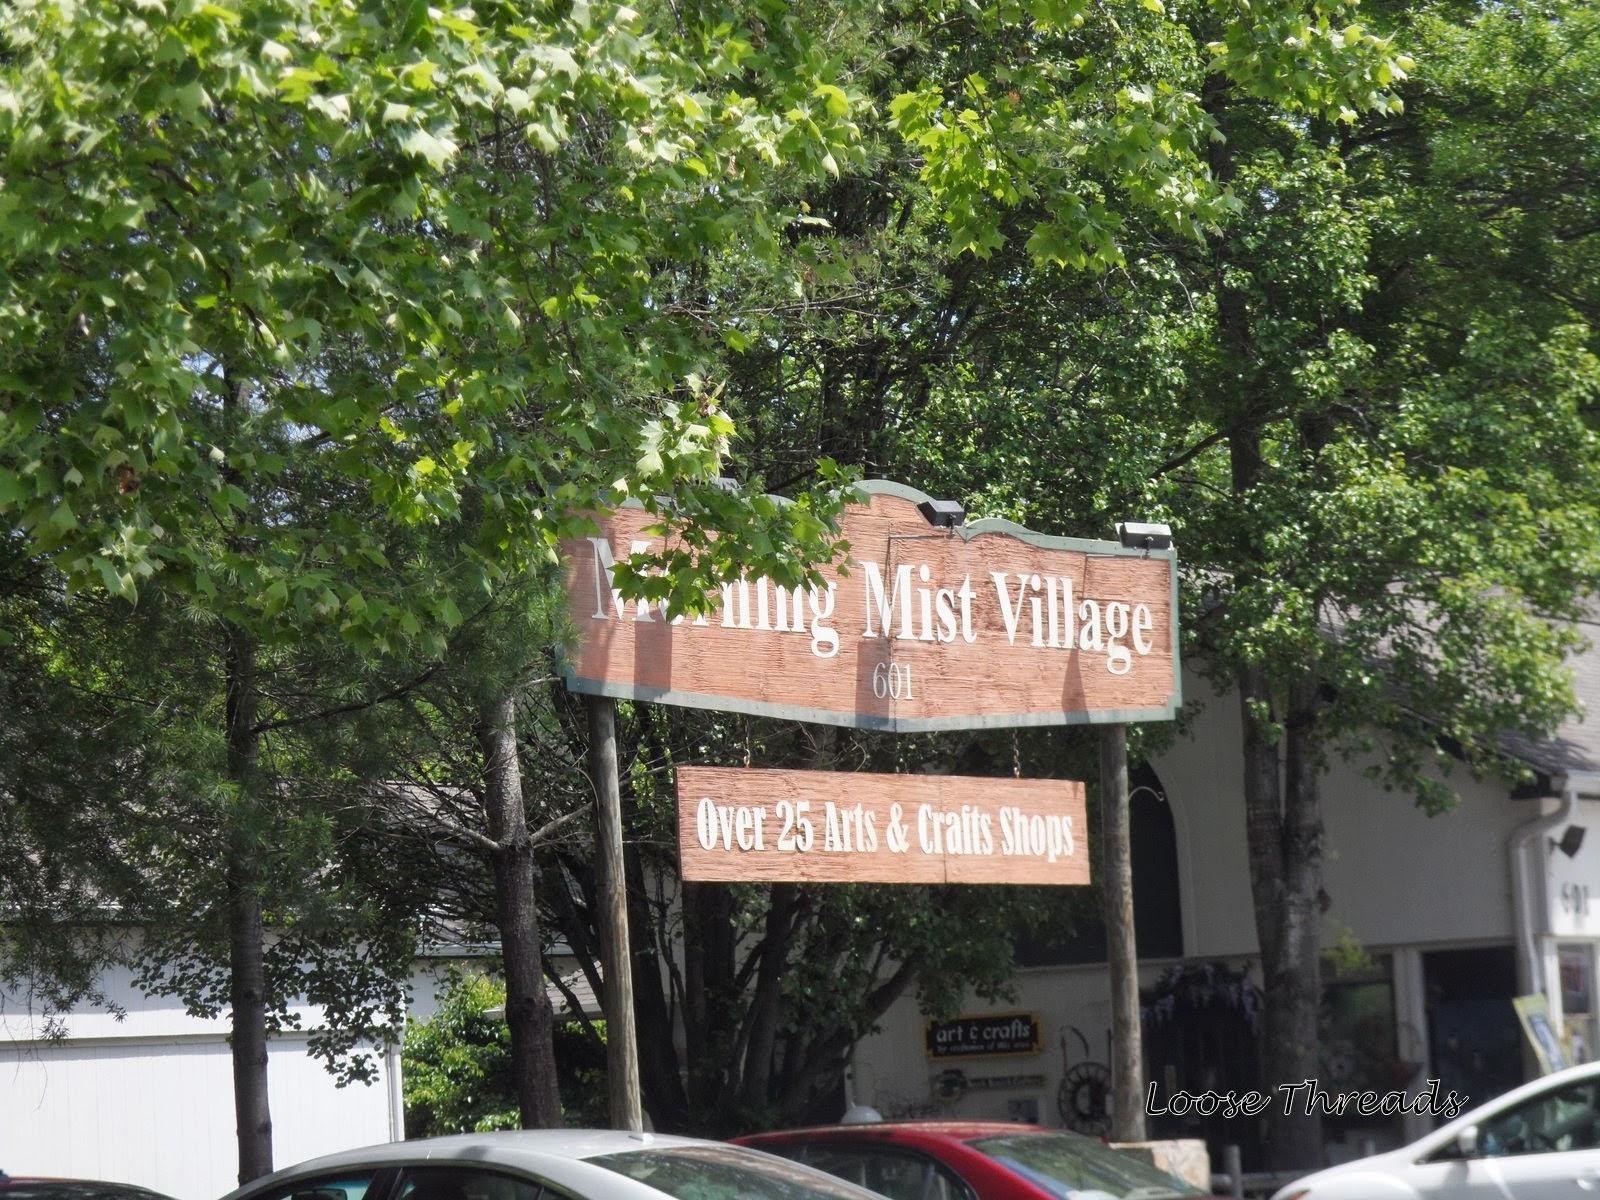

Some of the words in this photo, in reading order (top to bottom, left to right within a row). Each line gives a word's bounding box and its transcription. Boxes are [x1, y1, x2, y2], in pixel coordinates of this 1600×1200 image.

[586, 537, 840, 658] Mning
[859, 561, 977, 644] Mist
[989, 571, 1153, 675] Village
[872, 662, 914, 700] 601
[697, 797, 766, 851] Over
[775, 800, 814, 852] 25
[824, 801, 878, 853] Arts
[886, 802, 910, 853] &
[918, 803, 994, 855] Crafts
[1000, 806, 1074, 863] Shops
[936, 1025, 964, 1043] art
[982, 1018, 1031, 1041] crafts
